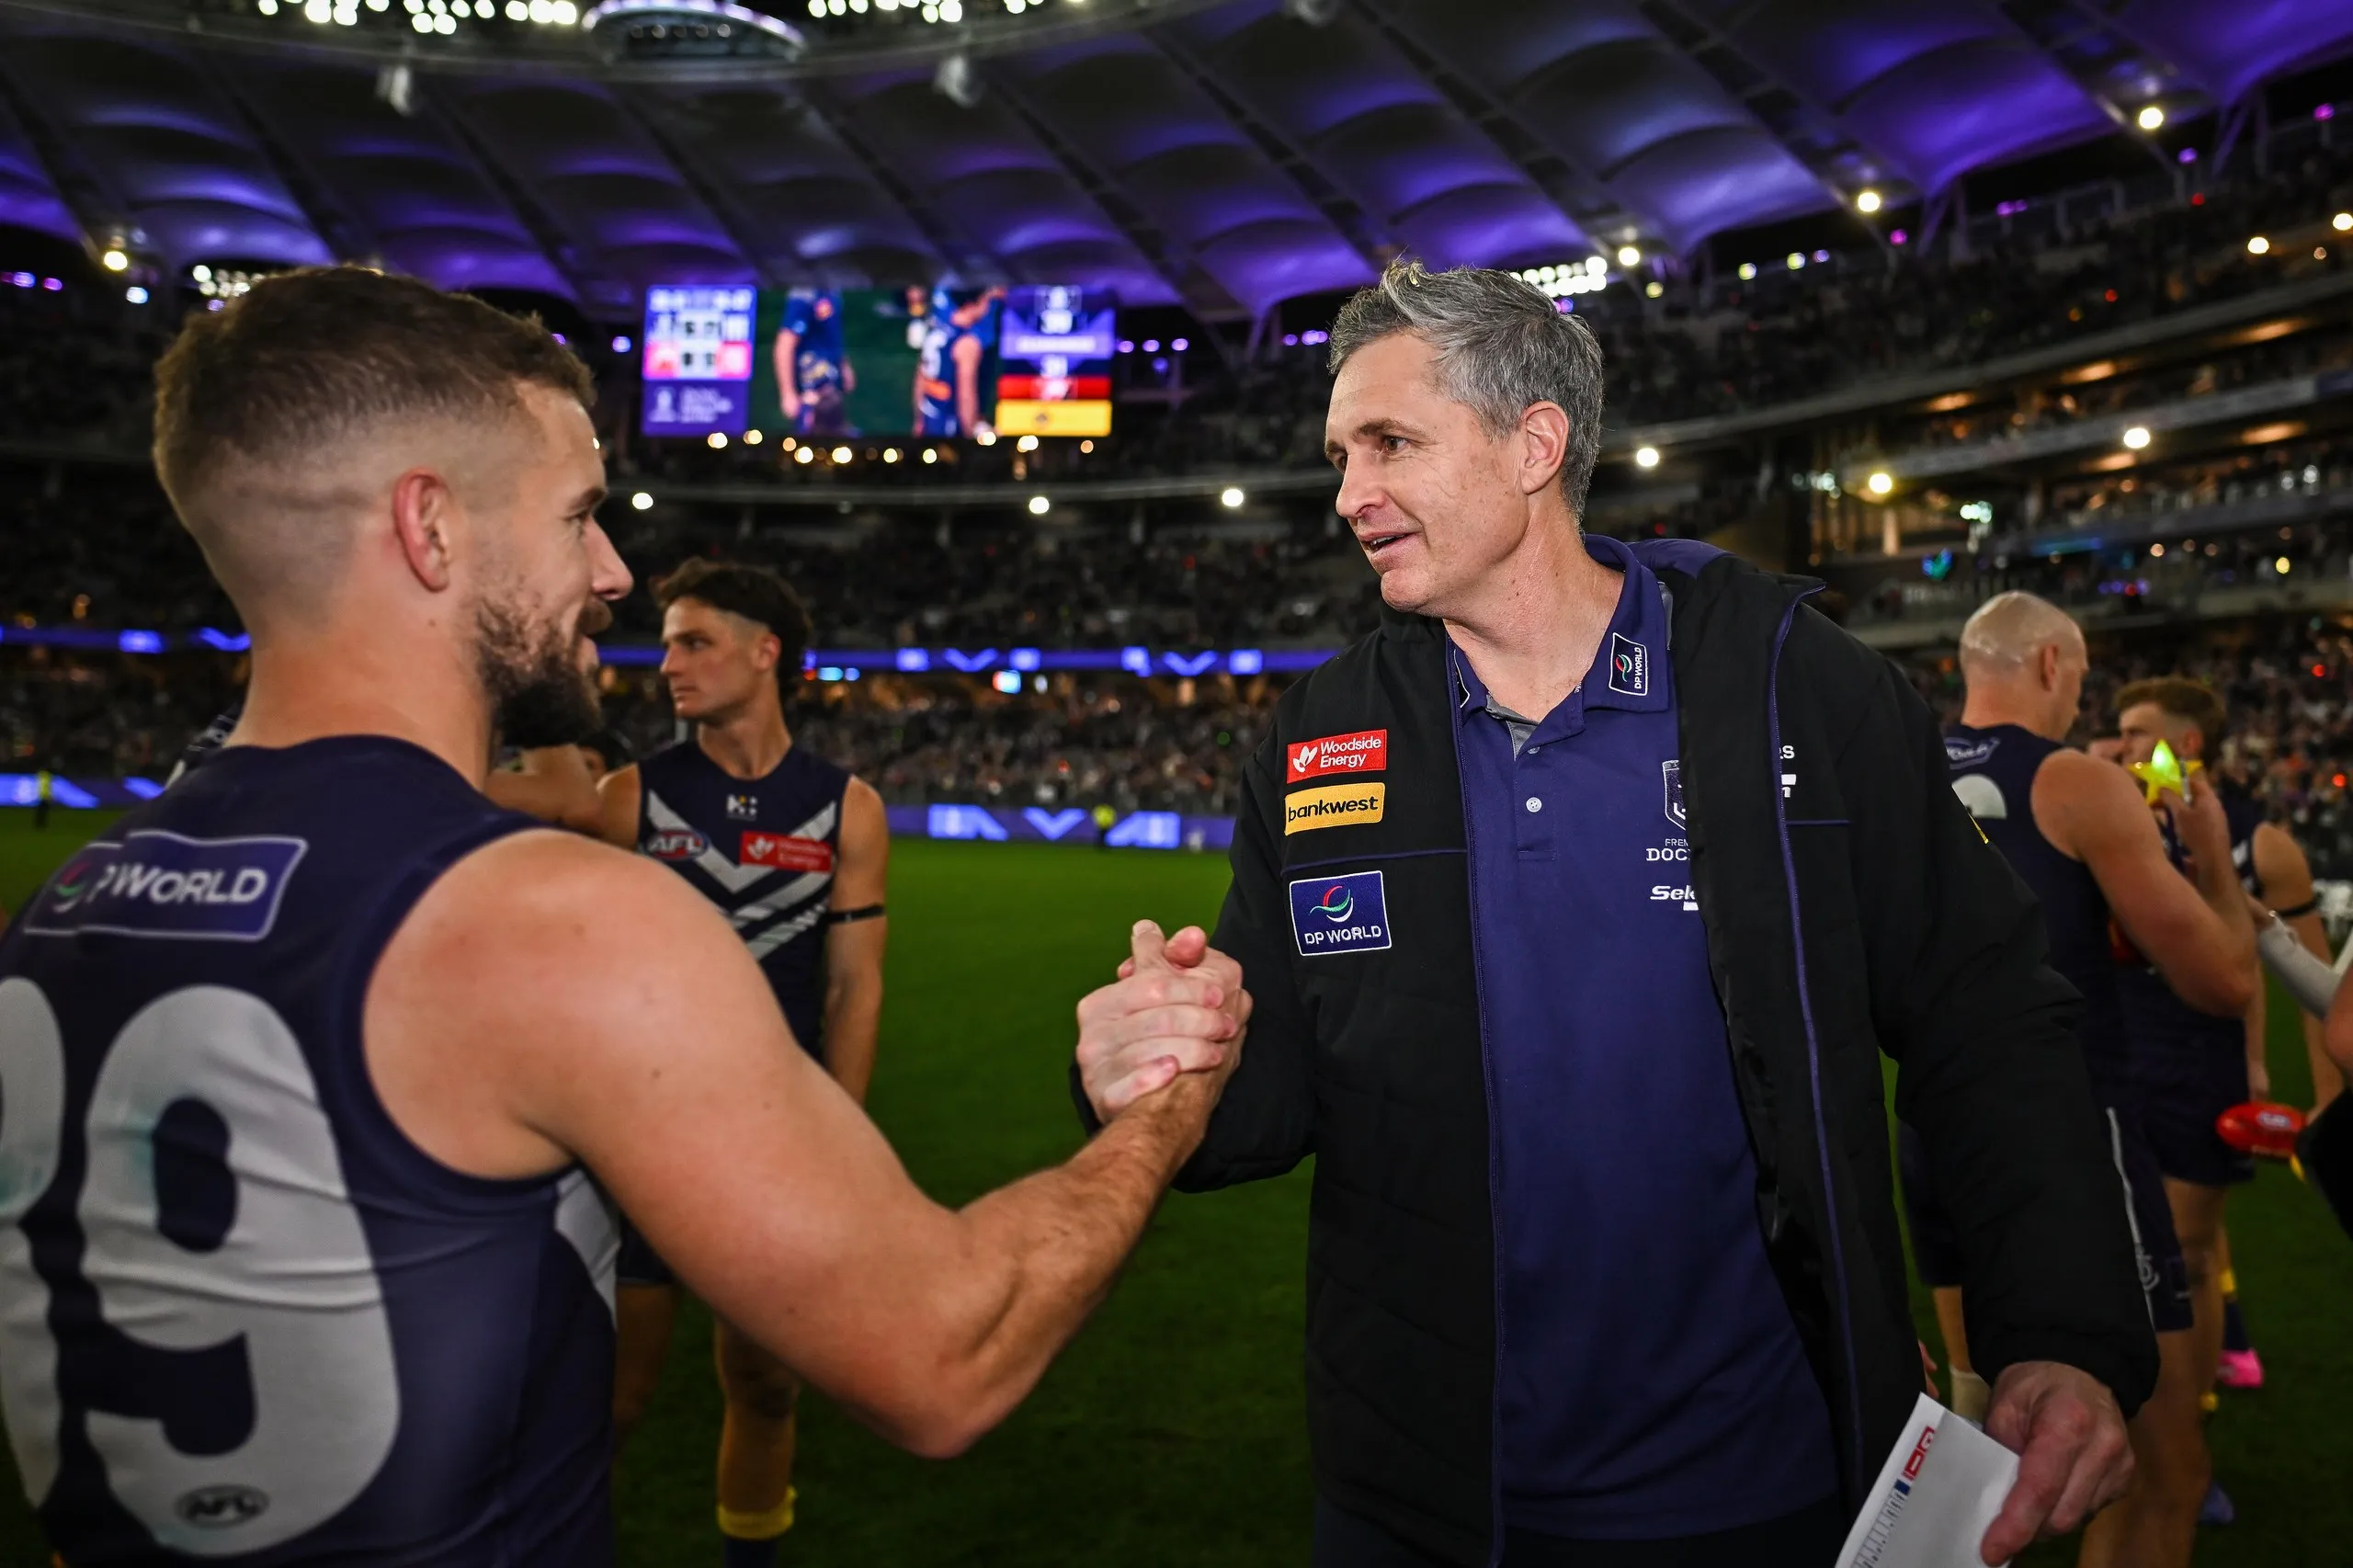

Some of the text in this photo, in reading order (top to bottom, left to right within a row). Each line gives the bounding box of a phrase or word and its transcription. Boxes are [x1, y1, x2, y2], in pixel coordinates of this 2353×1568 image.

[1633, 647, 1643, 689] DP WORLD
[1320, 736, 1381, 755] Woodside
[1320, 754, 1367, 768] Energy
[1288, 796, 1379, 823] bankwest
[647, 834, 702, 856] AFL
[1645, 847, 1691, 861] DOC
[113, 864, 268, 904] WORLD
[1304, 925, 1382, 945] DP WORLD
